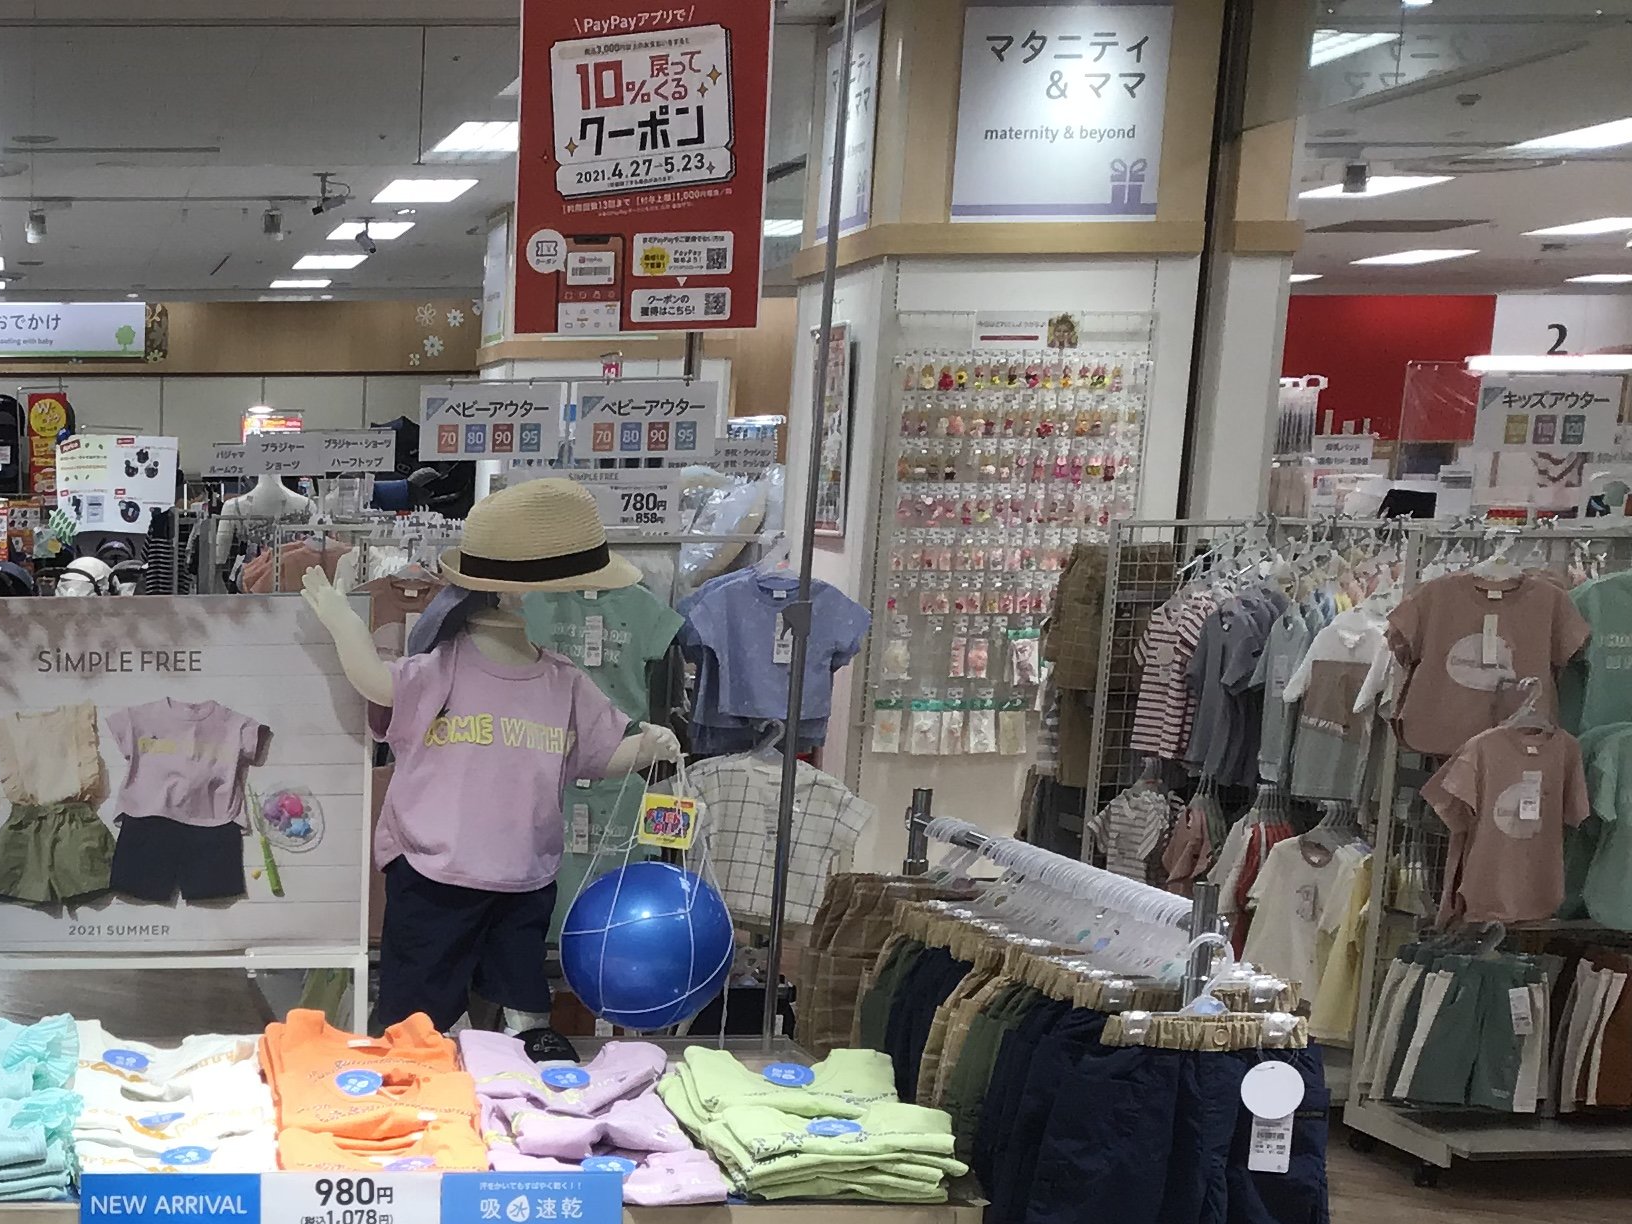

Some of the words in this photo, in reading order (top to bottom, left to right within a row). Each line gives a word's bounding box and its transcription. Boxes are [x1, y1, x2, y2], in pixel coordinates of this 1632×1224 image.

[583, 8, 686, 34] PayPayアプリで
[985, 29, 1150, 64] マタニティ
[649, 51, 702, 79] 戻って
[654, 78, 689, 102] くる
[1045, 70, 1068, 100] &
[1084, 72, 1147, 99] ママ
[579, 105, 705, 156] クーポン
[984, 125, 1059, 143] maternity
[1063, 125, 1075, 140] &
[1079, 124, 1136, 143] beyond
[647, 293, 690, 305] クーポンの
[38, 337, 54, 346] baby
[1546, 323, 1569, 356] 2
[445, 400, 550, 419] ベビーアウター
[600, 398, 706, 418] ベビーアウター
[1502, 390, 1611, 410] キッズアウター
[440, 431, 457, 445] 70
[467, 431, 484, 445] 80
[494, 431, 512, 445] 90
[521, 430, 539, 445] 95
[595, 430, 612, 445] 70
[622, 430, 640, 444] 80
[650, 430, 667, 443] 90
[677, 428, 694, 443] 95
[260, 443, 305, 452] ブラジャー
[265, 460, 301, 471] ショーツ
[331, 457, 384, 468] ハーフトップ
[621, 493, 667, 511] 780円
[140, 649, 203, 673] FREE
[500, 717, 564, 754] WITH
[68, 925, 102, 936] 2021
[106, 924, 171, 936] SUMMER
[314, 1177, 393, 1206] 980円
[90, 1195, 148, 1215] NEW
[154, 1194, 247, 1215] ARRIVAL
[479, 1194, 584, 1222] 吸水速乾
